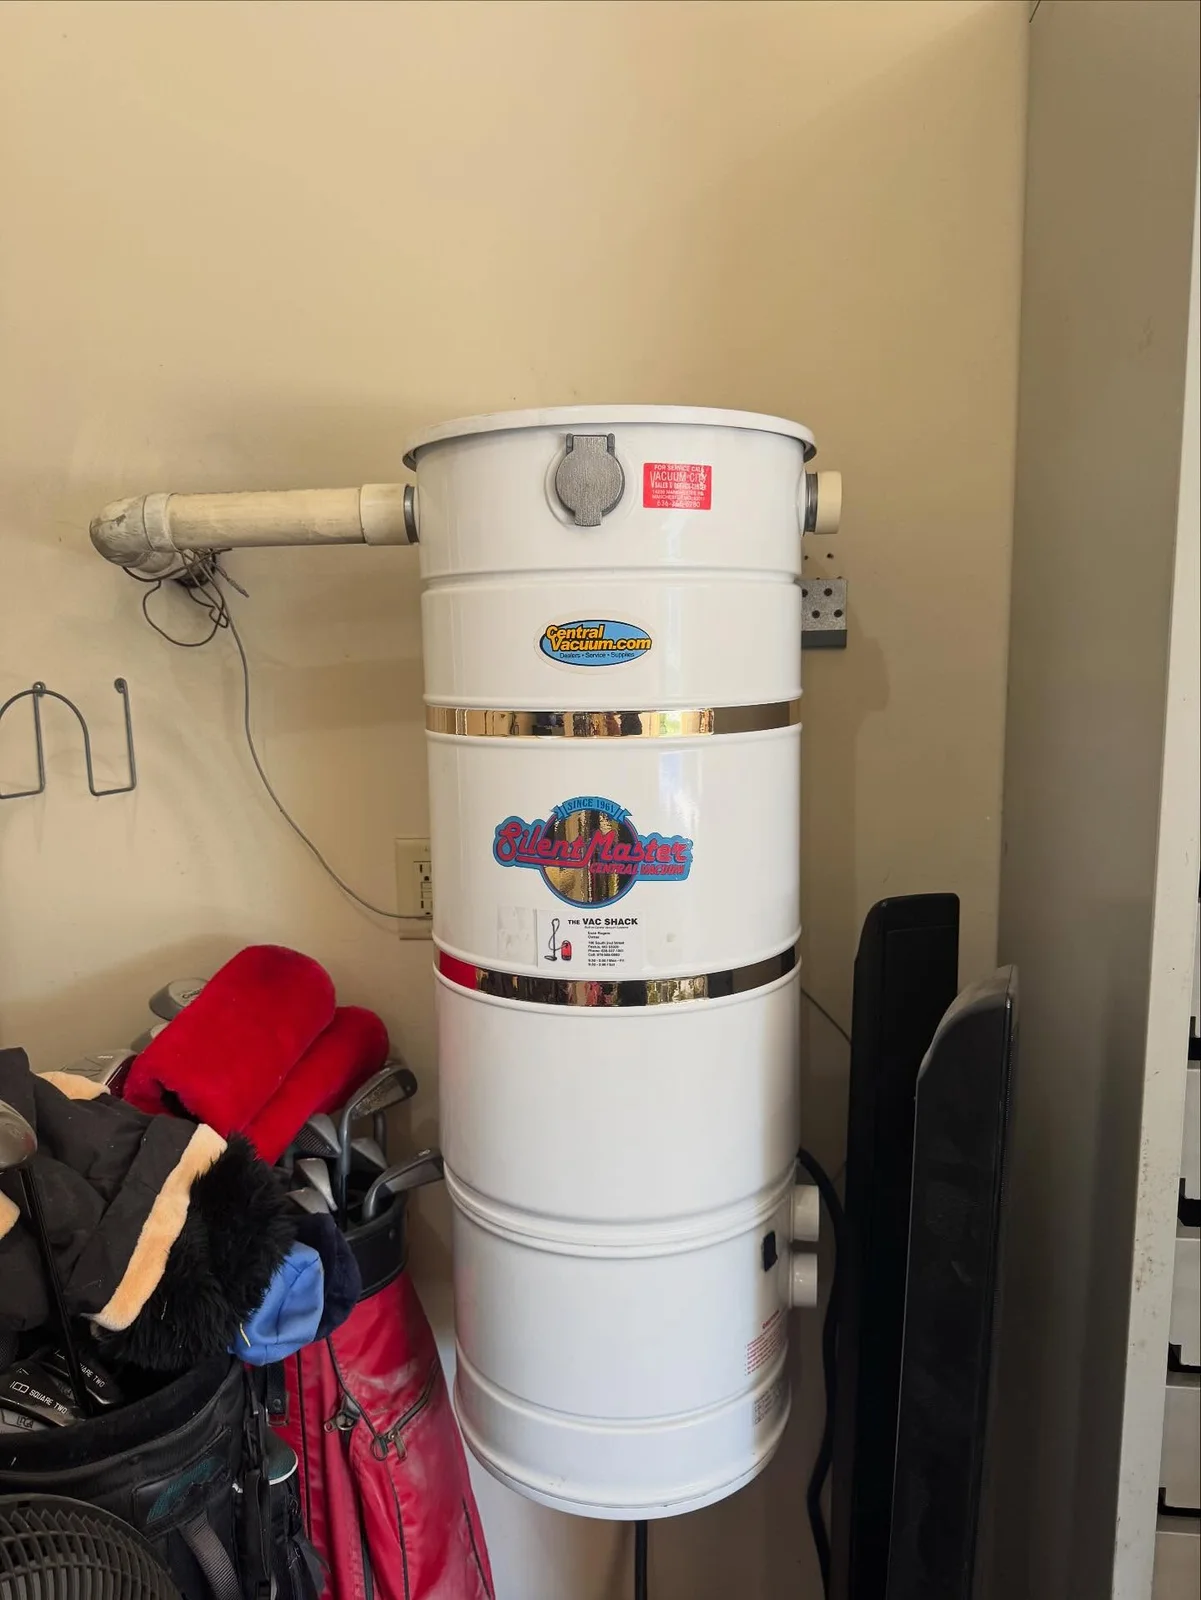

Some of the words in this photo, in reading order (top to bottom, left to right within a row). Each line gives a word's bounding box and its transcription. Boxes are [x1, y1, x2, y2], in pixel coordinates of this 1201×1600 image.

[650, 471, 687, 488] VACUUM
[546, 625, 605, 640] Central
[549, 636, 652, 651] Vacuum.com
[567, 798, 593, 811] SINCE
[596, 799, 614, 813] 1961
[497, 821, 585, 861] Silent
[586, 829, 688, 866] Master
[590, 862, 638, 875] CENTRAL
[641, 863, 685, 875] VACUUM
[92, 1375, 105, 1388] TWO
[29, 1389, 54, 1406] SQUARE
[53, 1403, 68, 1414] TWO
